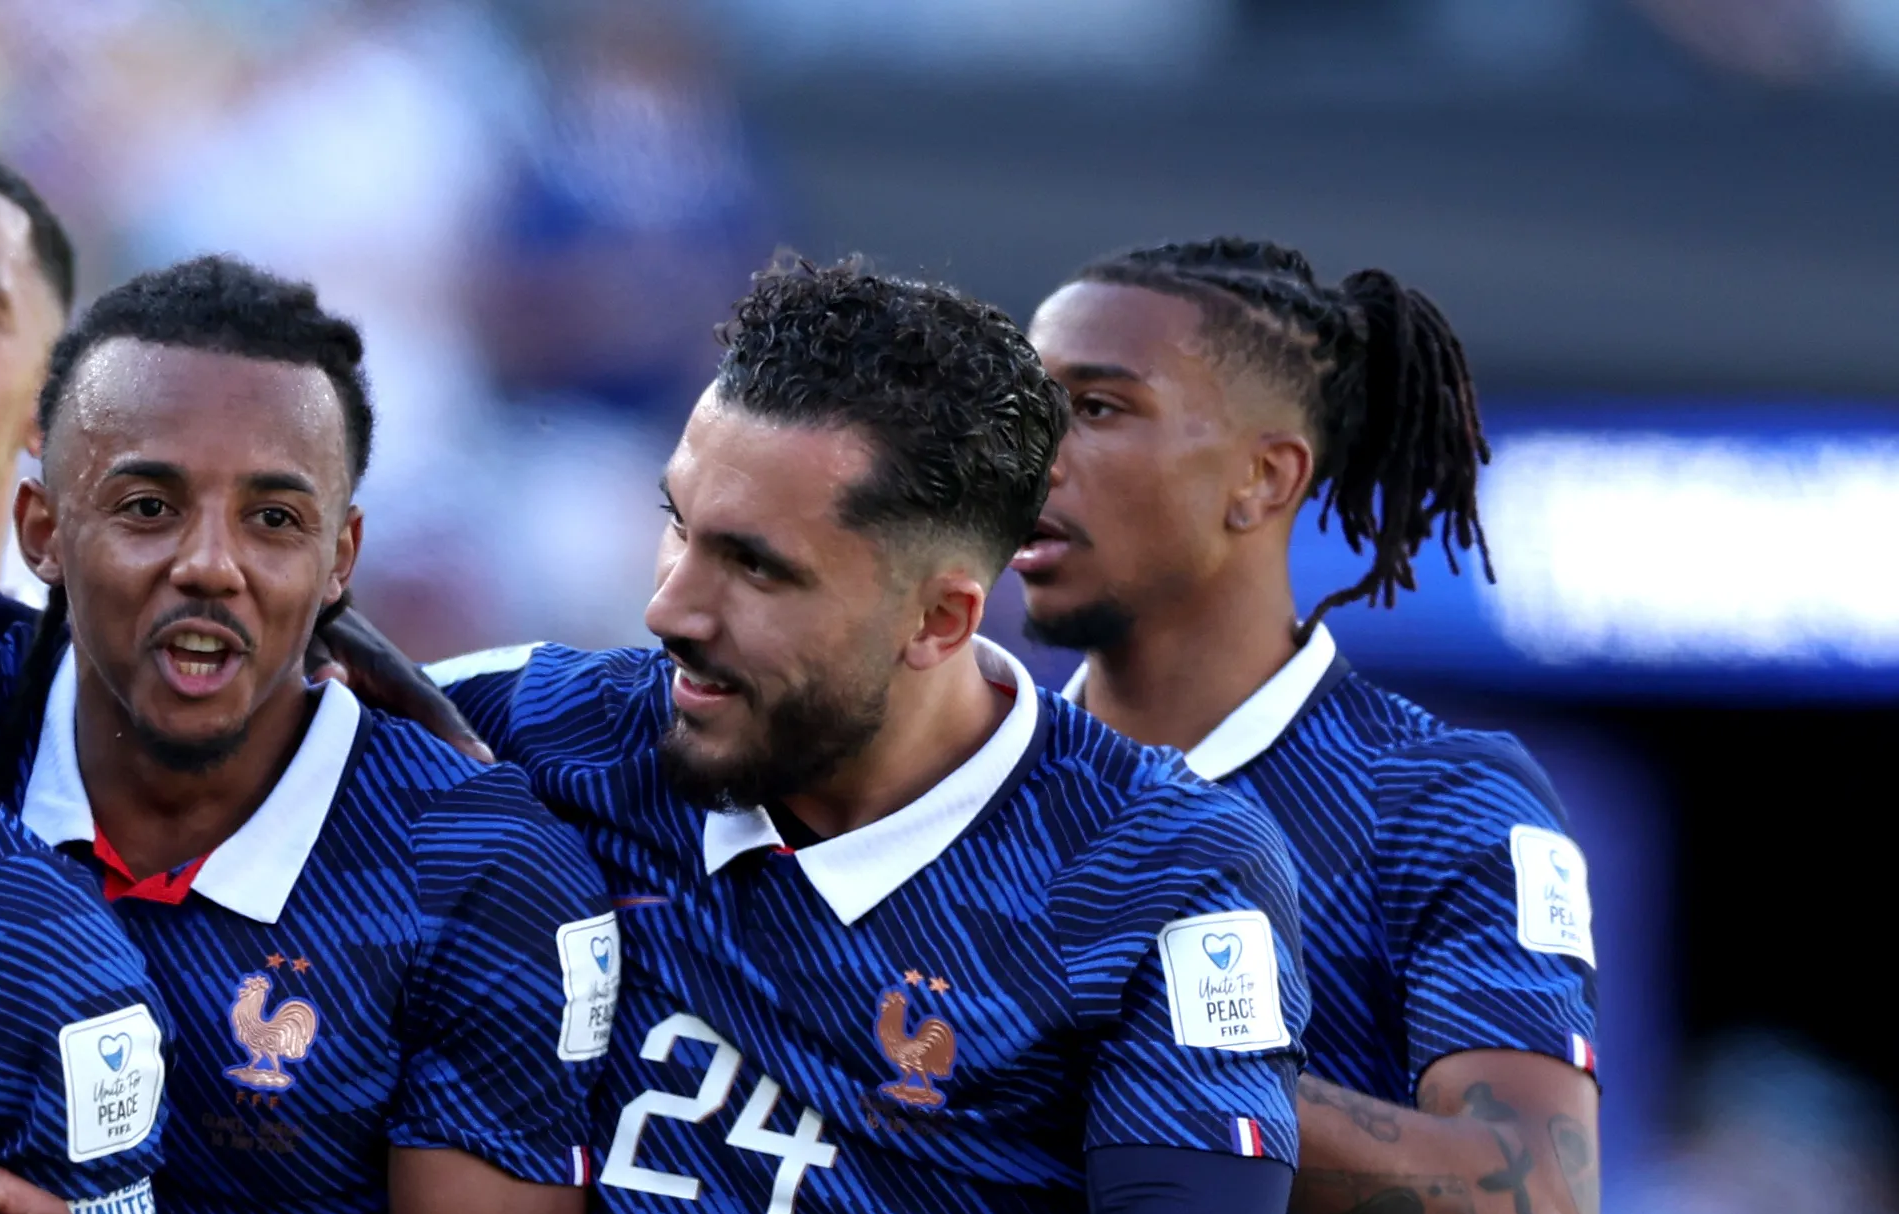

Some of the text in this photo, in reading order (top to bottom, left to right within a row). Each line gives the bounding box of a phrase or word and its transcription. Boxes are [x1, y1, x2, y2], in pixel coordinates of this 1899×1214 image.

[1199, 974, 1235, 1000] Unite
[1206, 998, 1256, 1024] PEACE
[1220, 1023, 1250, 1037] FIFA
[93, 1069, 142, 1102] Unite For
[98, 1093, 139, 1126] PEACE
[107, 1123, 132, 1138] FIFA
